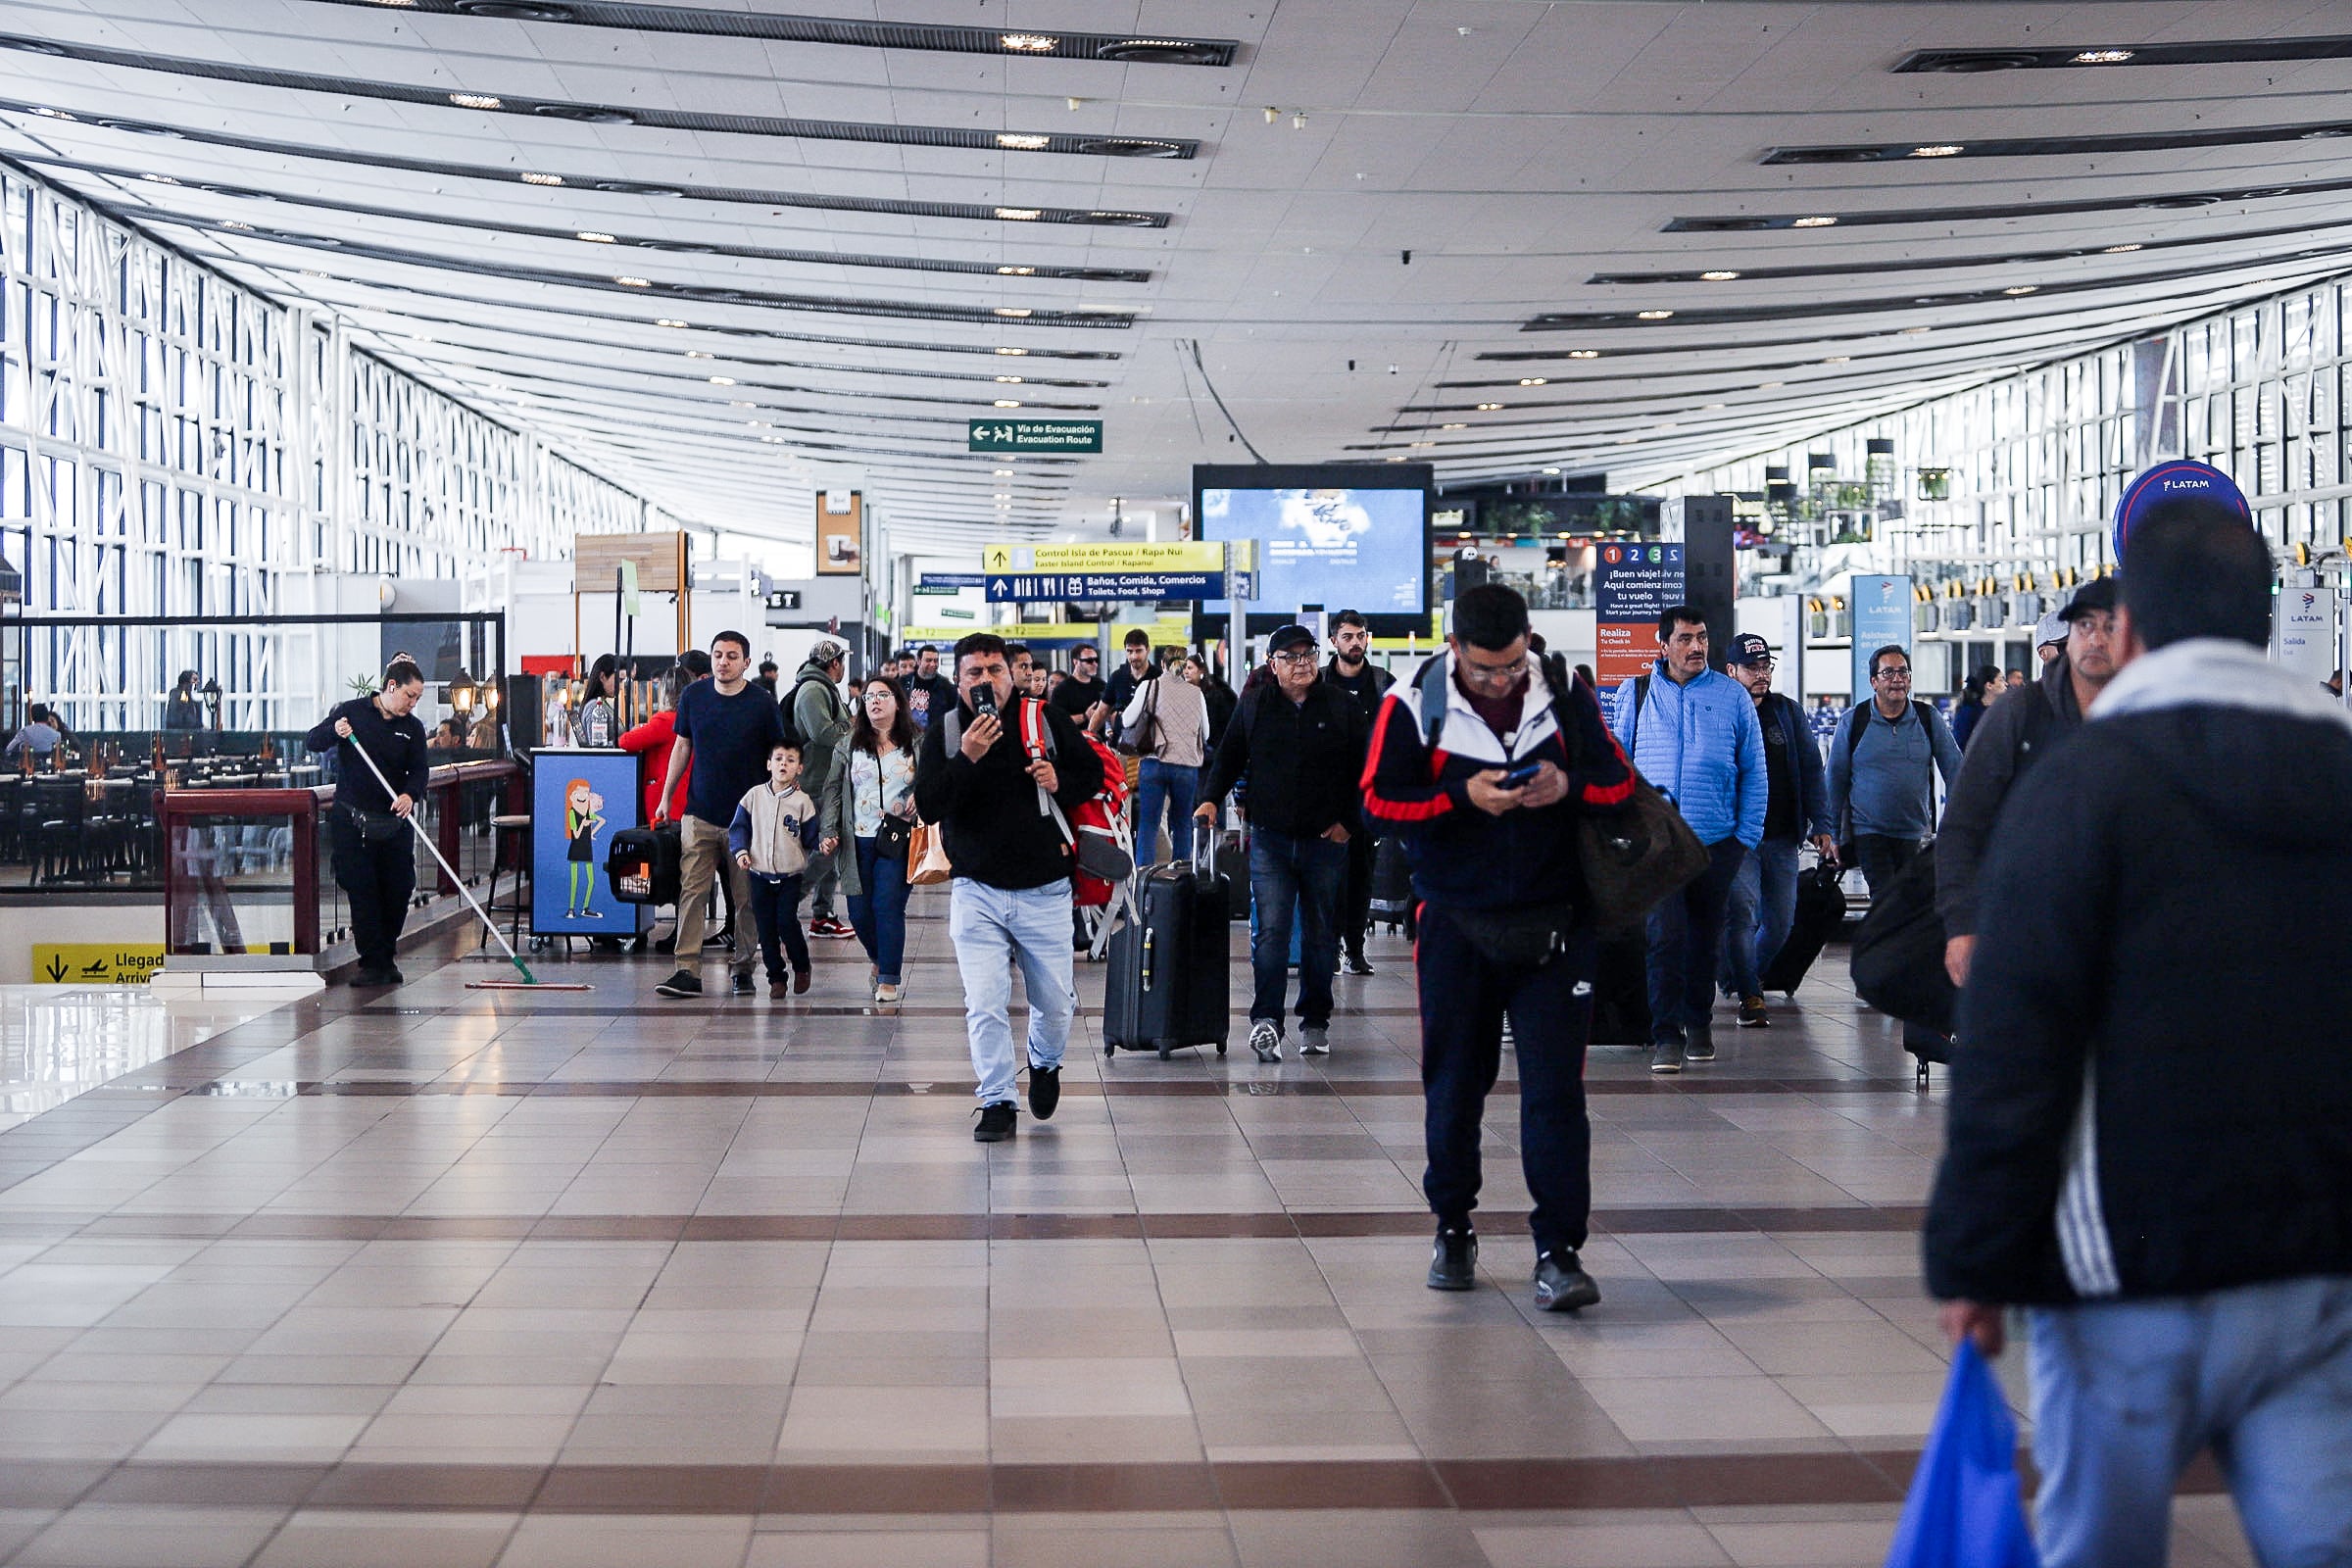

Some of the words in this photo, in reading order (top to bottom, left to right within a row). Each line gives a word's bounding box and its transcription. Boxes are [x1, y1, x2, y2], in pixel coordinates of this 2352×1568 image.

[1046, 424, 1095, 433] Evacuación
[1609, 549, 1616, 561] 1
[1631, 549, 1639, 561] 2
[1653, 549, 1661, 561] 3
[1609, 569, 1635, 579] ¡Buen
[1637, 569, 1661, 579] viaje!
[1087, 576, 1117, 586] Baños,
[1119, 576, 1156, 585] Comida,
[1158, 575, 1205, 584] Comercios
[1603, 581, 1624, 590] Aquí
[1118, 587, 1140, 596] Food,
[1142, 587, 1165, 596] Shops
[1600, 628, 1631, 637] Realiza
[116, 953, 164, 969] Llegad
[116, 972, 151, 983] Arriv
